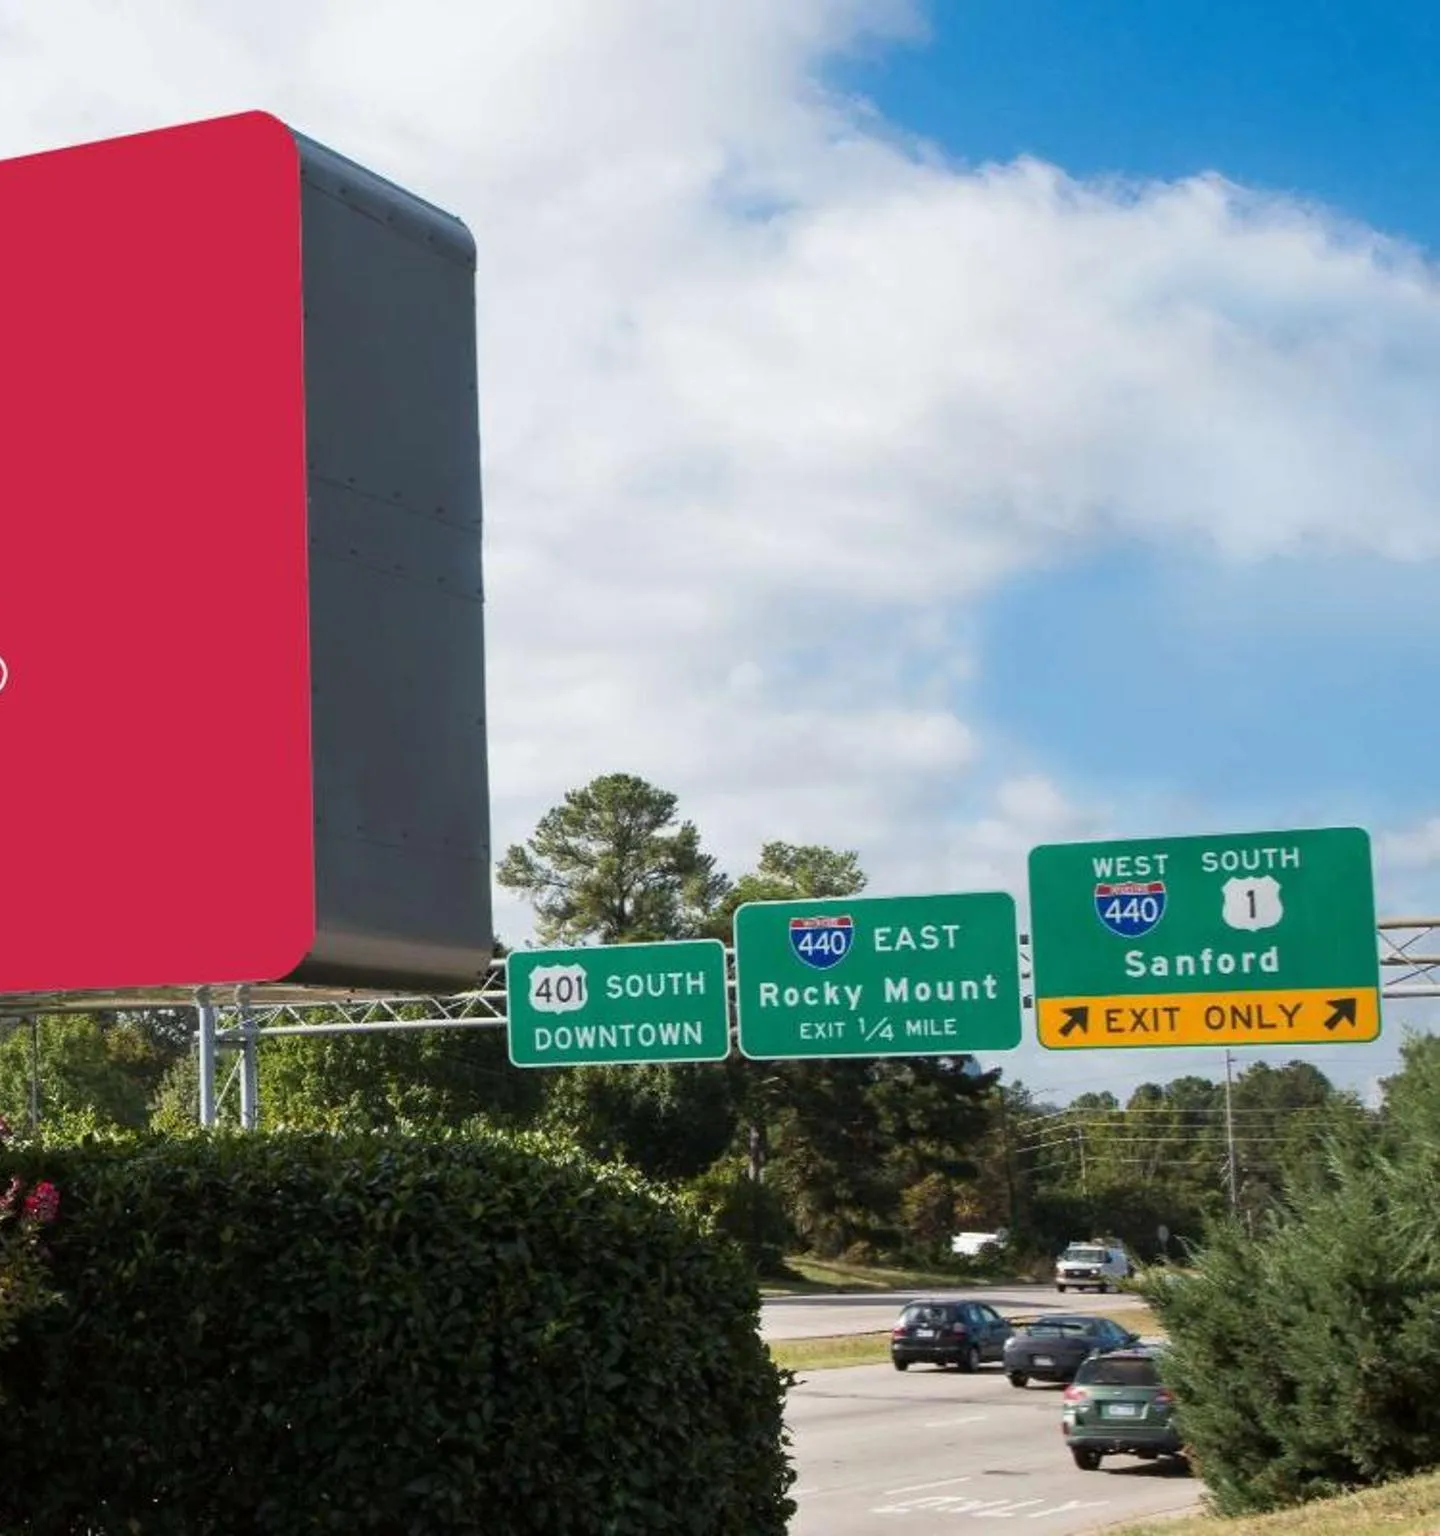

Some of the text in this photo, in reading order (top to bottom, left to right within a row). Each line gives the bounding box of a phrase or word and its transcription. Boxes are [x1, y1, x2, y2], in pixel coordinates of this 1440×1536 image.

[1093, 847, 1301, 878] WEST SOUTH
[1104, 898, 1158, 923] 440
[1246, 889, 1257, 919] 1
[797, 924, 960, 956] 440 EAST
[1124, 946, 1280, 978] Sanford
[536, 971, 706, 1003] 401 SOUTH
[759, 973, 998, 1011] Rocky Mount
[799, 1021, 846, 1040] EXIT
[905, 1017, 958, 1036] MILE
[1105, 1002, 1303, 1033] EXIT ONLY
[535, 1020, 703, 1051] DOWNTOWN
